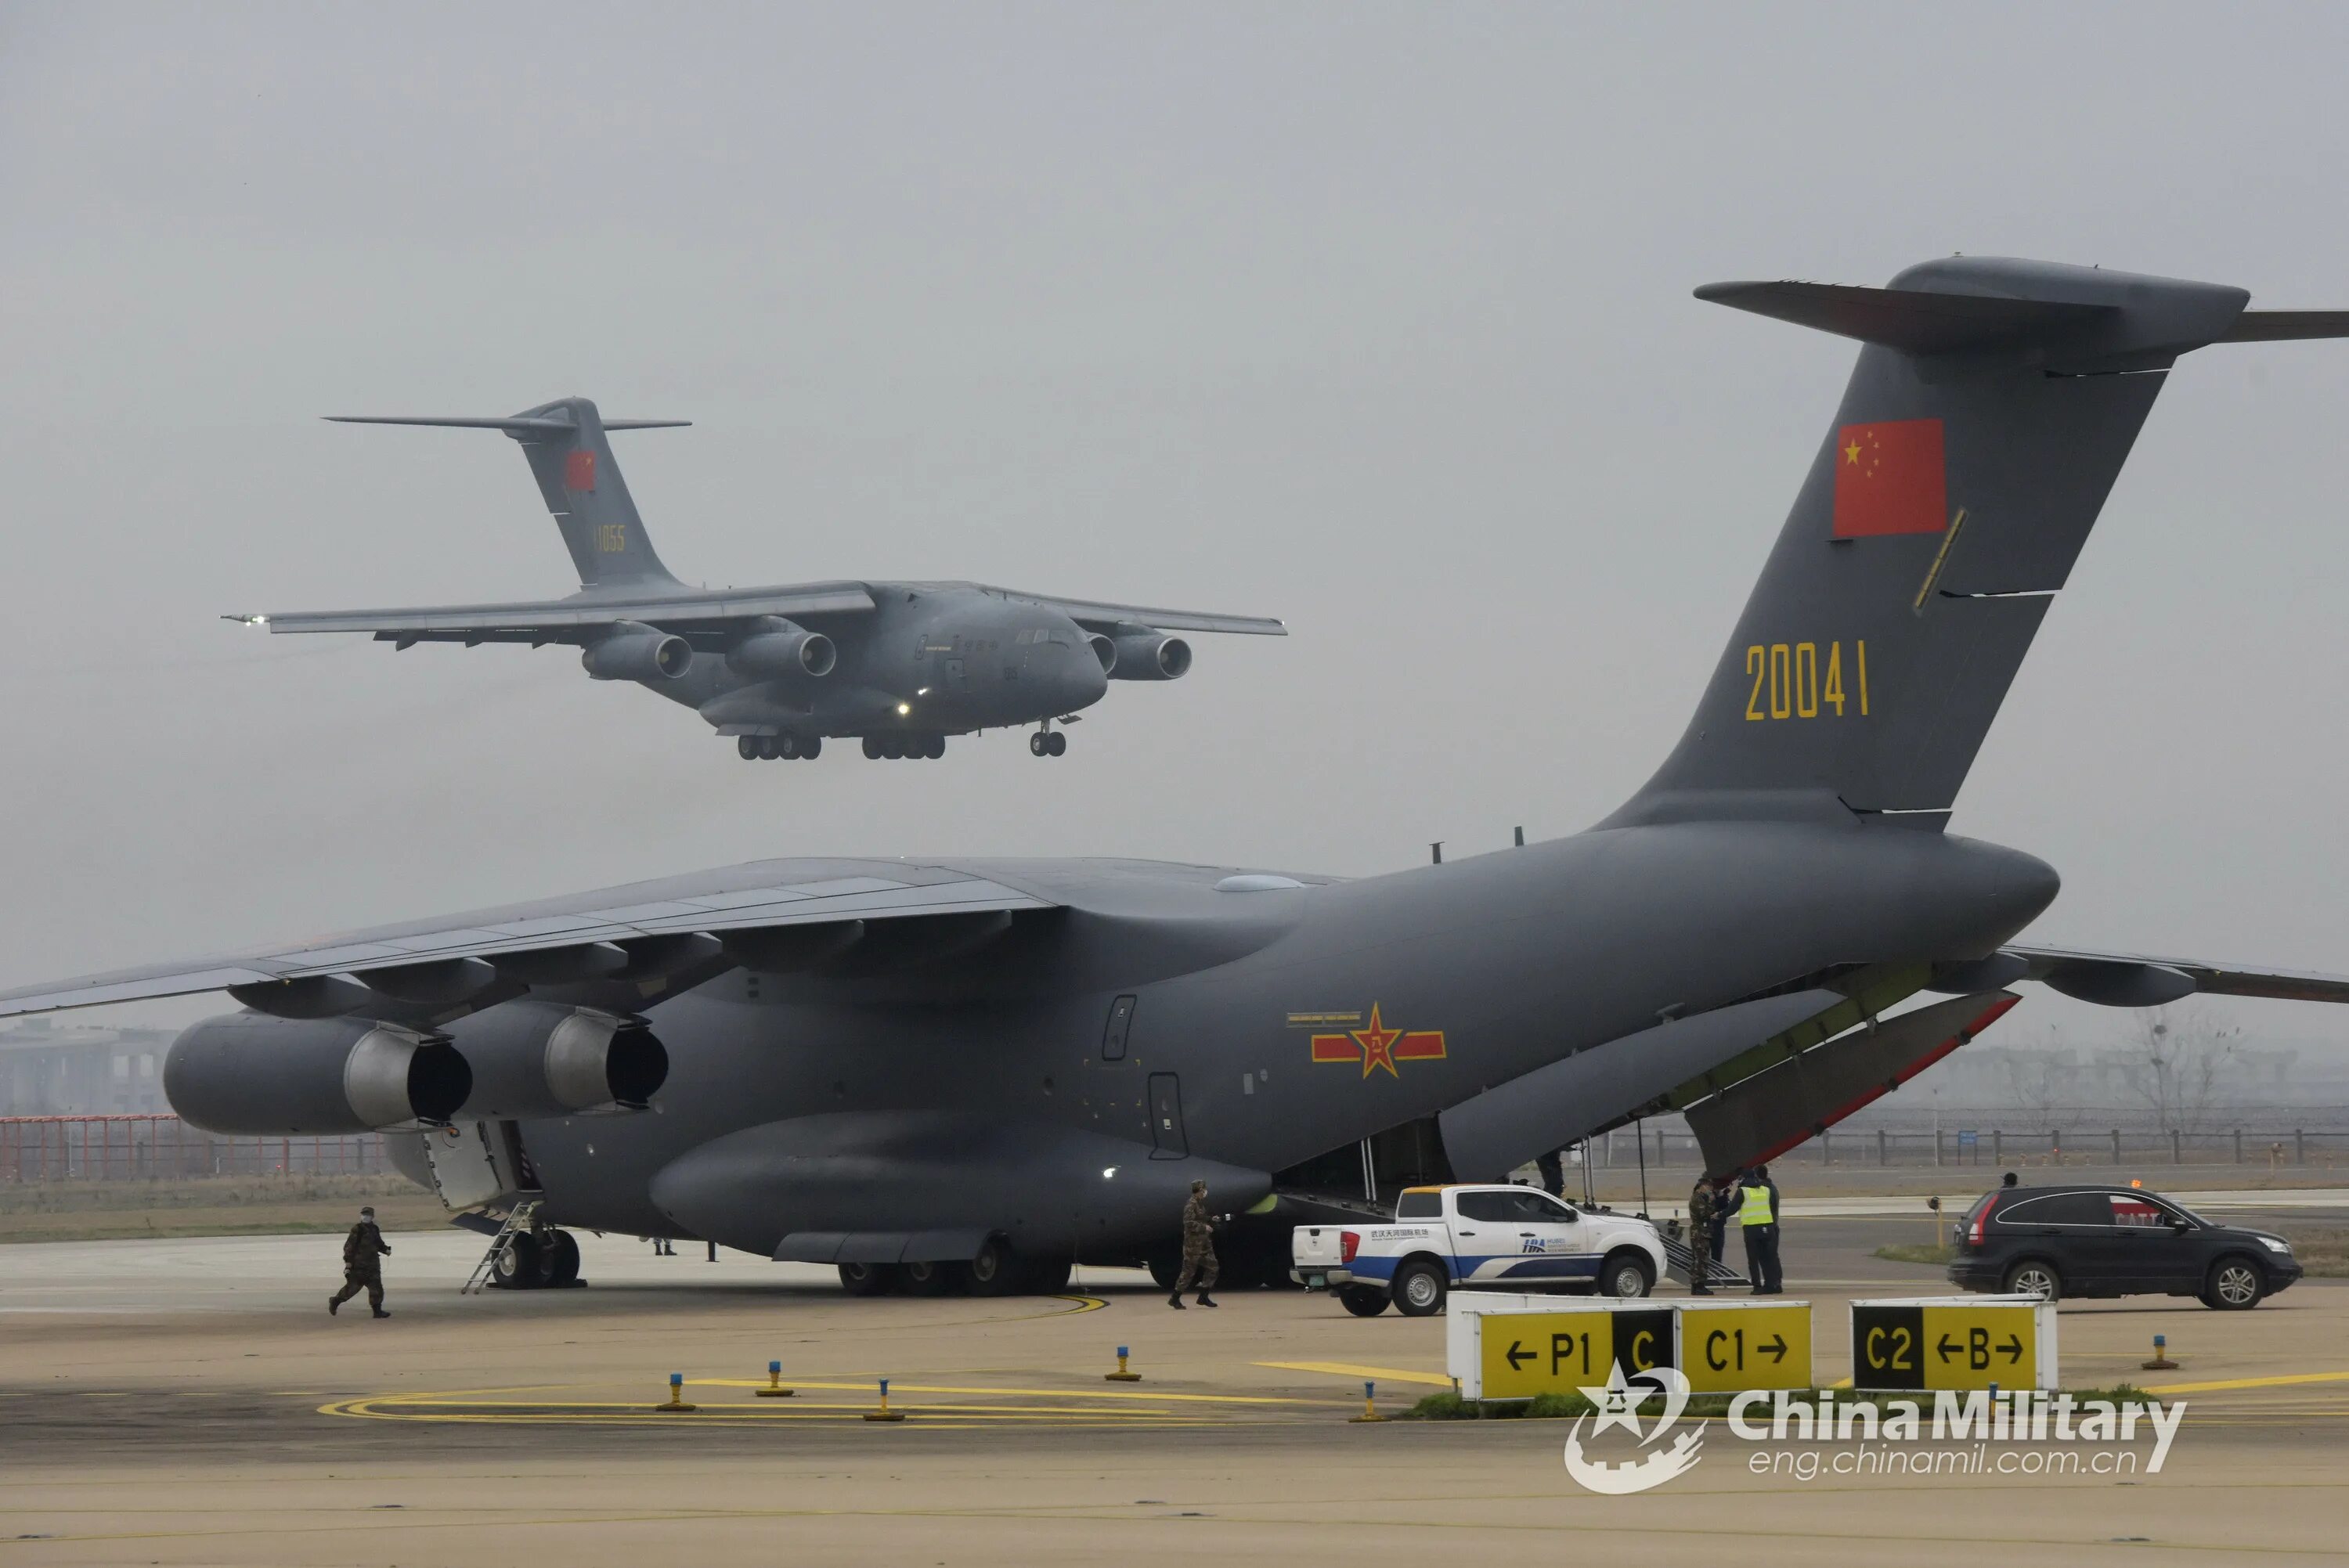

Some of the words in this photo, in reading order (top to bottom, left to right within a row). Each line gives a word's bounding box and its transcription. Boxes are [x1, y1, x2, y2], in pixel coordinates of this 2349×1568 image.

[1746, 640, 1868, 720] 20041
[1552, 1332, 1589, 1375] P1
[1632, 1330, 1654, 1372] C
[1706, 1328, 1743, 1371] C1
[1867, 1327, 1912, 1369] C2
[1970, 1328, 1990, 1370] B
